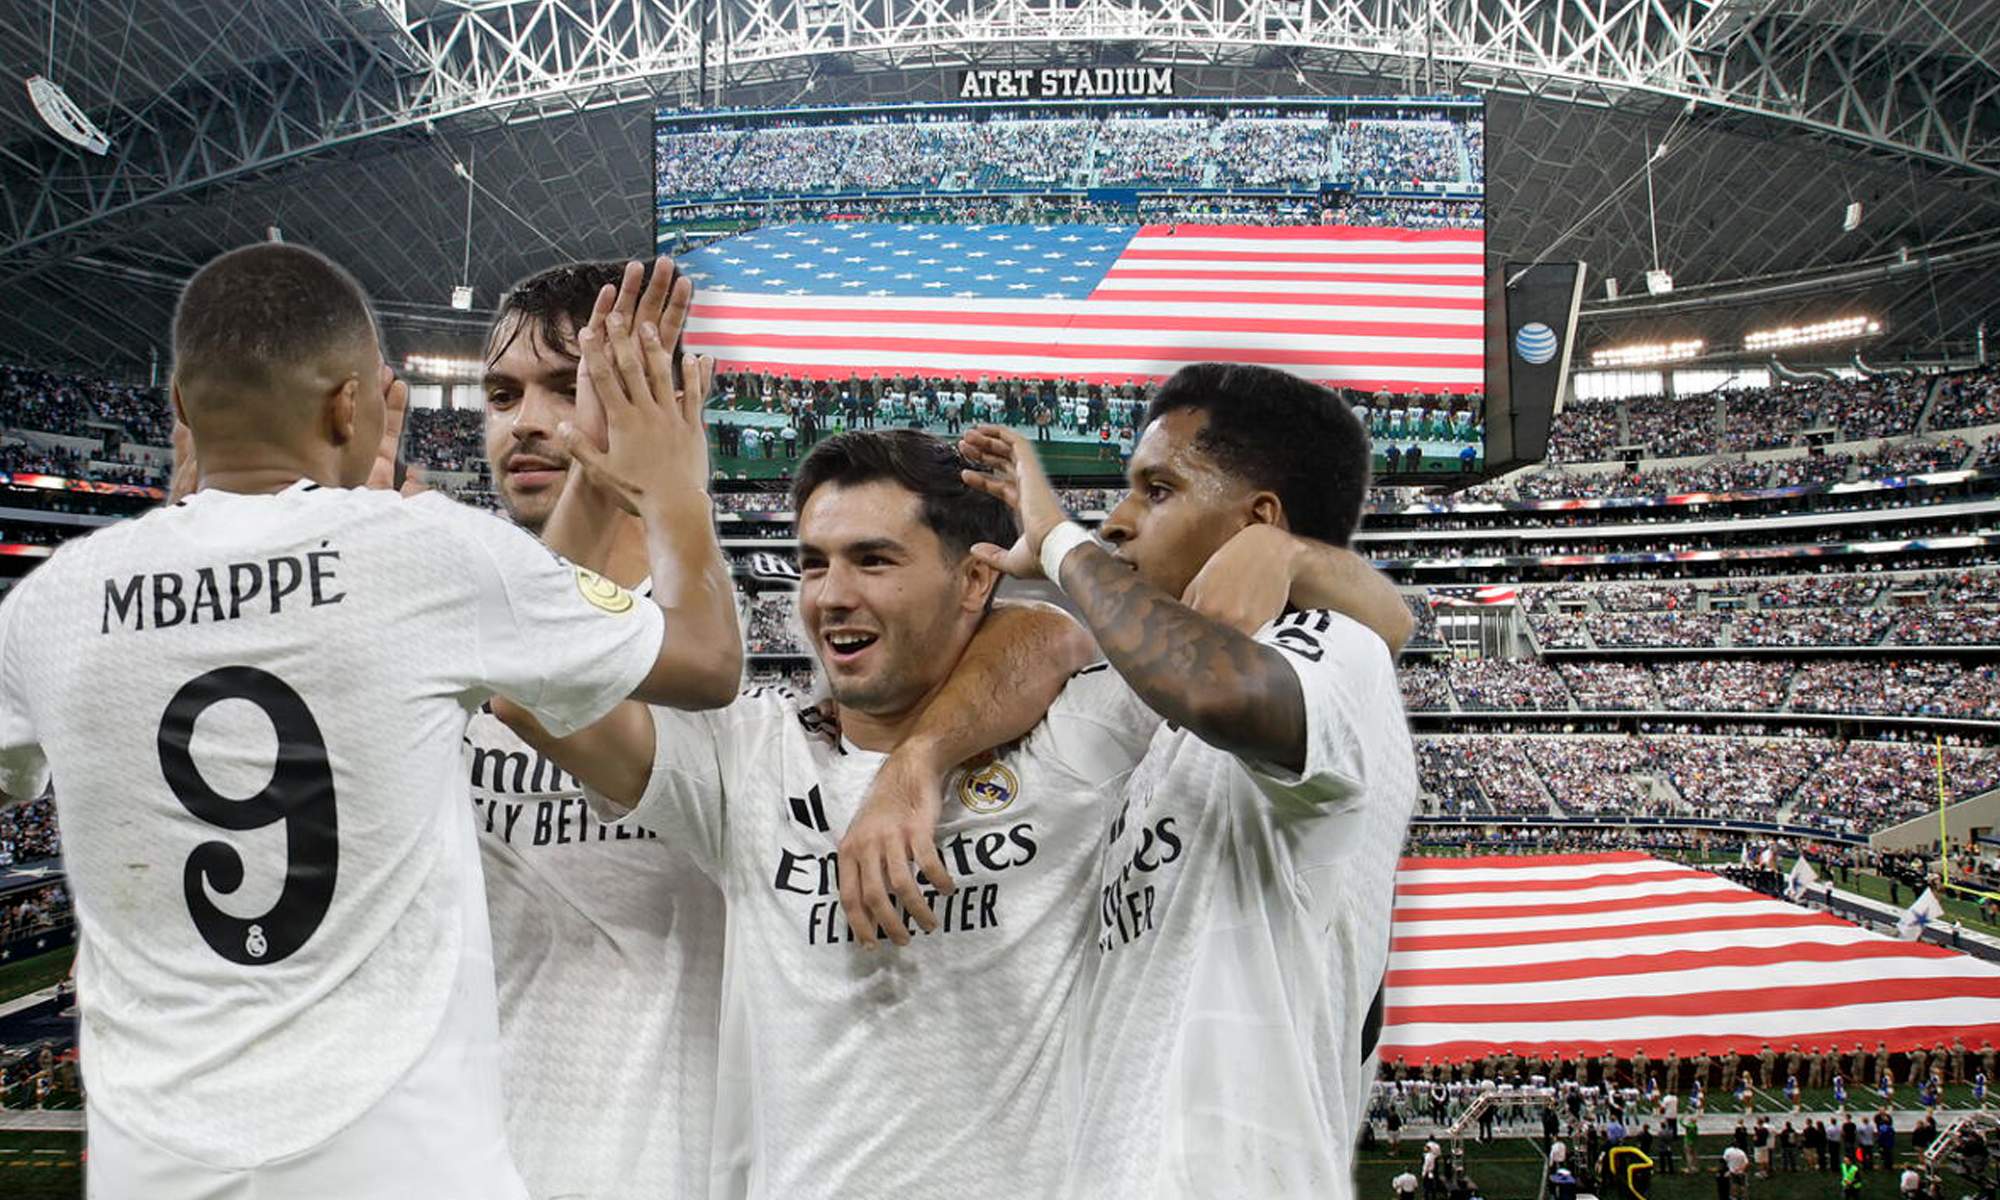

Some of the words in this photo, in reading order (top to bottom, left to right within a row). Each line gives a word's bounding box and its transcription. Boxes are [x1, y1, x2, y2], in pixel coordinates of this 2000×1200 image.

[960, 68, 1034, 97] AT&T
[1041, 67, 1174, 96] STADIUM
[101, 540, 347, 634] MBAPPÉ
[157, 665, 339, 966] 9
